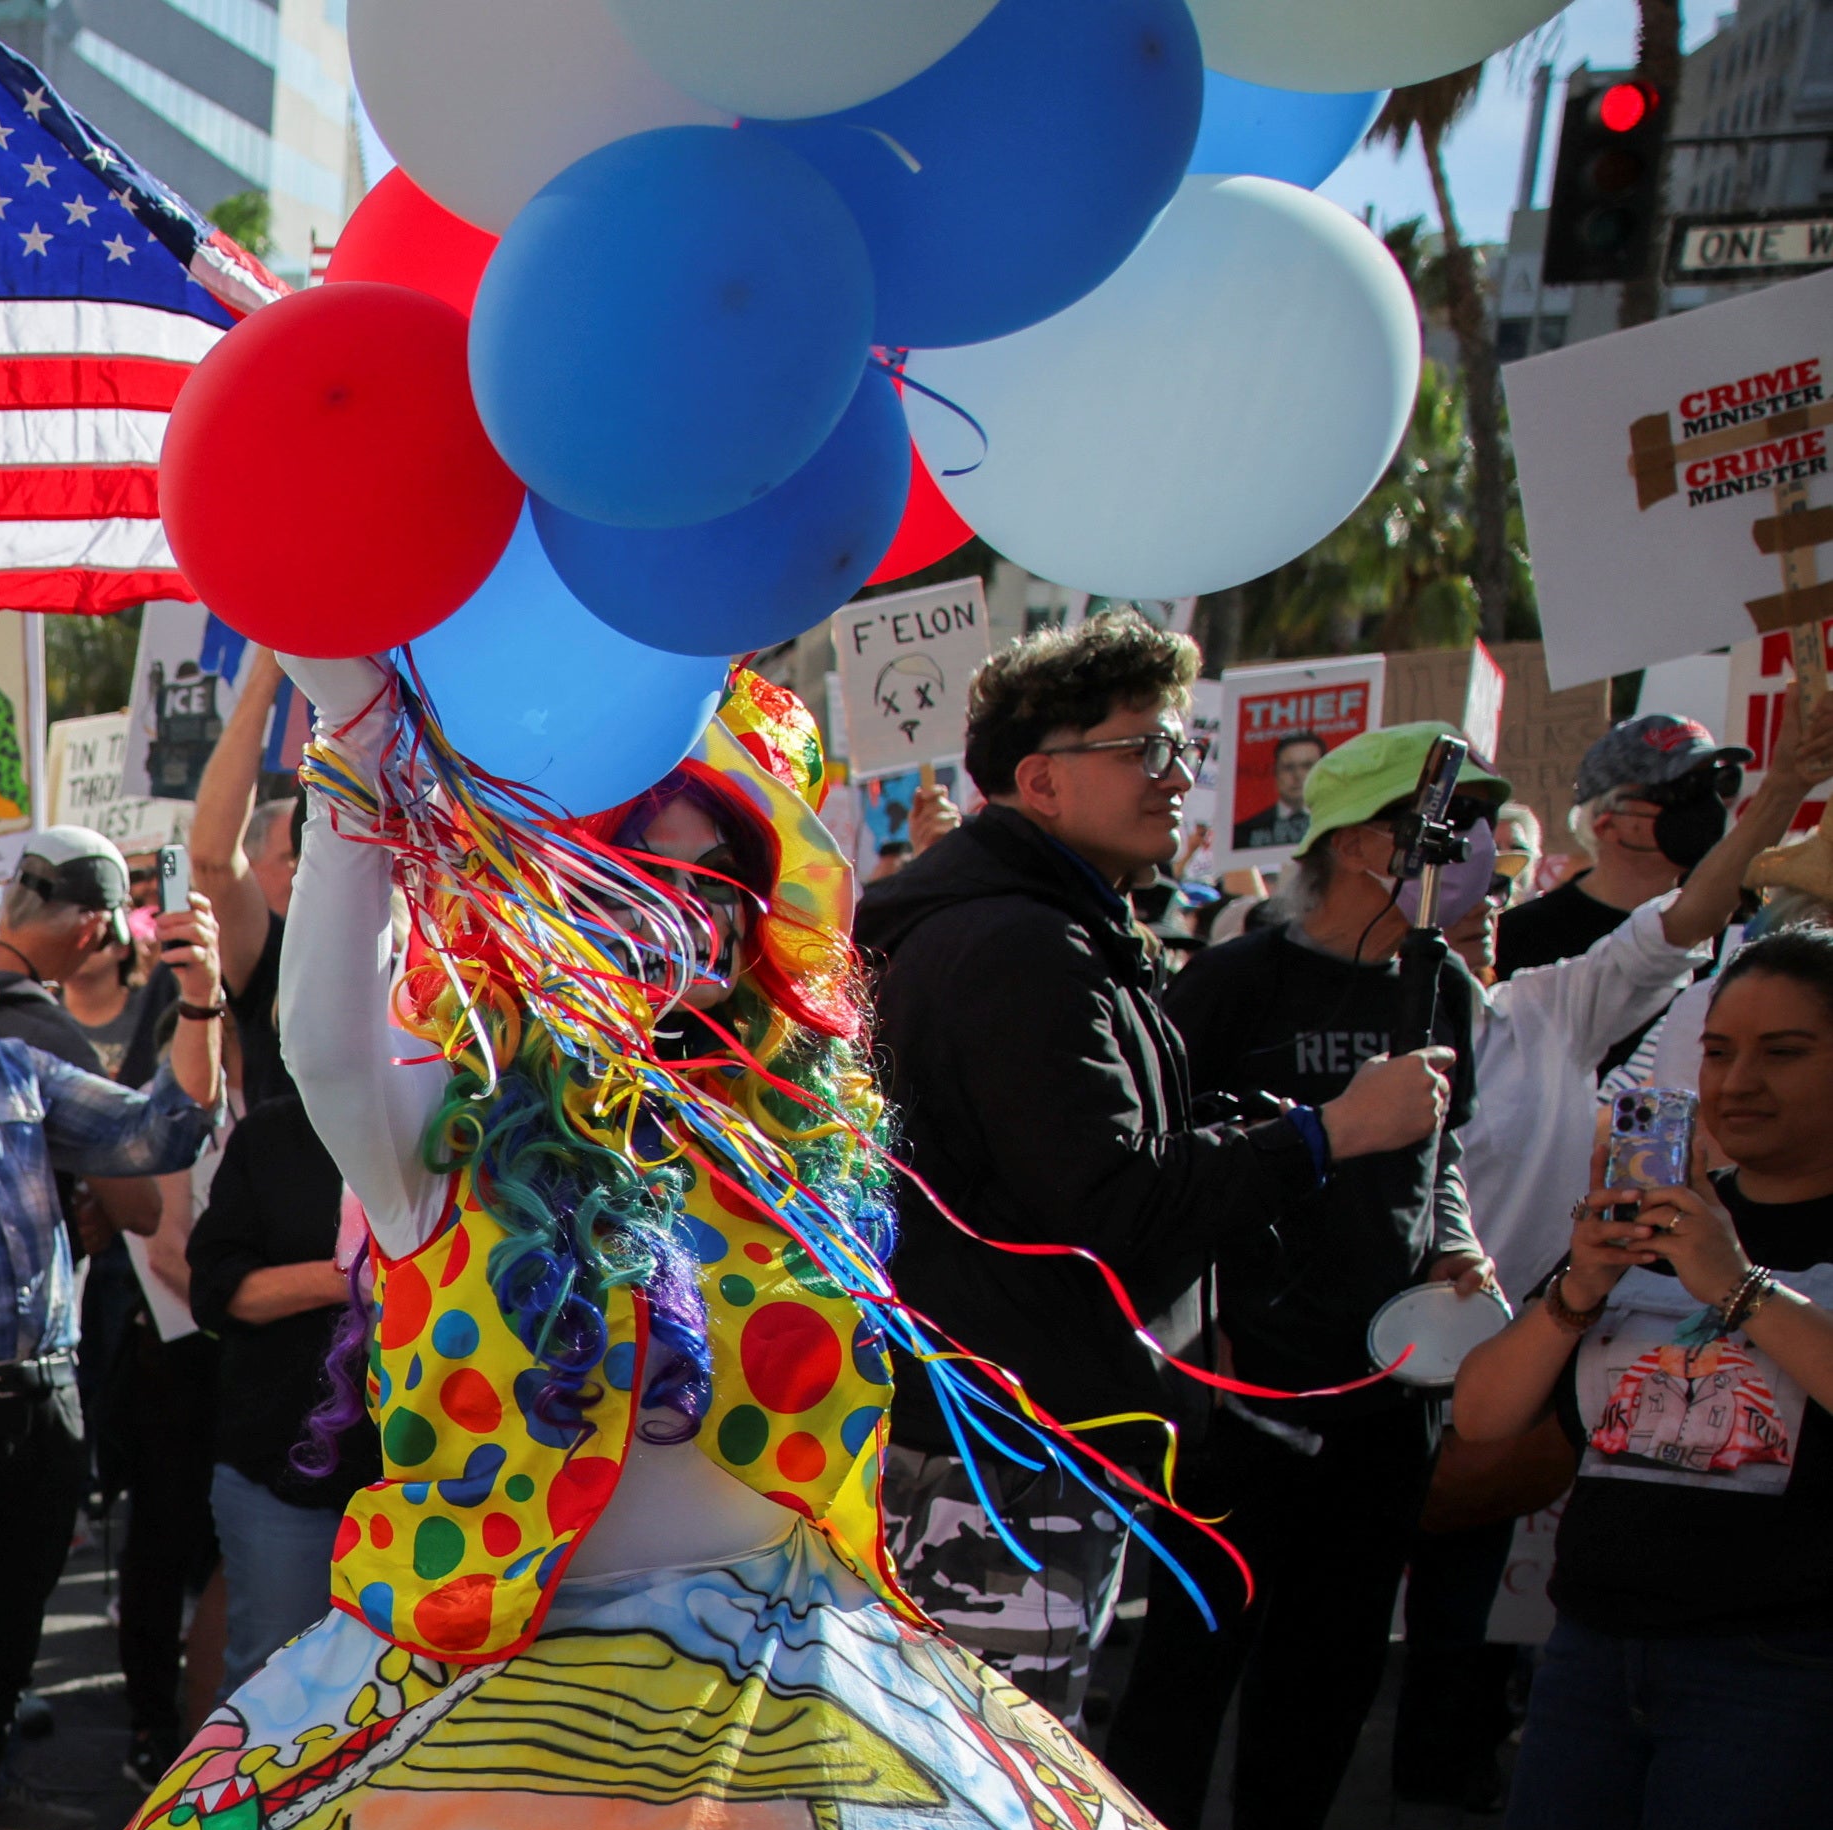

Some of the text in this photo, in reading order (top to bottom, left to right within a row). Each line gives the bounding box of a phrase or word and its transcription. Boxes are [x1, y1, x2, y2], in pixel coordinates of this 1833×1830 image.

[1700, 227, 1785, 265] ONE
[1679, 358, 1822, 418] CRIME
[1683, 385, 1824, 439] MINISTER
[1685, 430, 1827, 489] CRIME
[1688, 457, 1827, 508] MINISTER
[853, 602, 976, 654] F'ELON
[163, 687, 208, 718] ICE
[1245, 689, 1363, 728] THIEF
